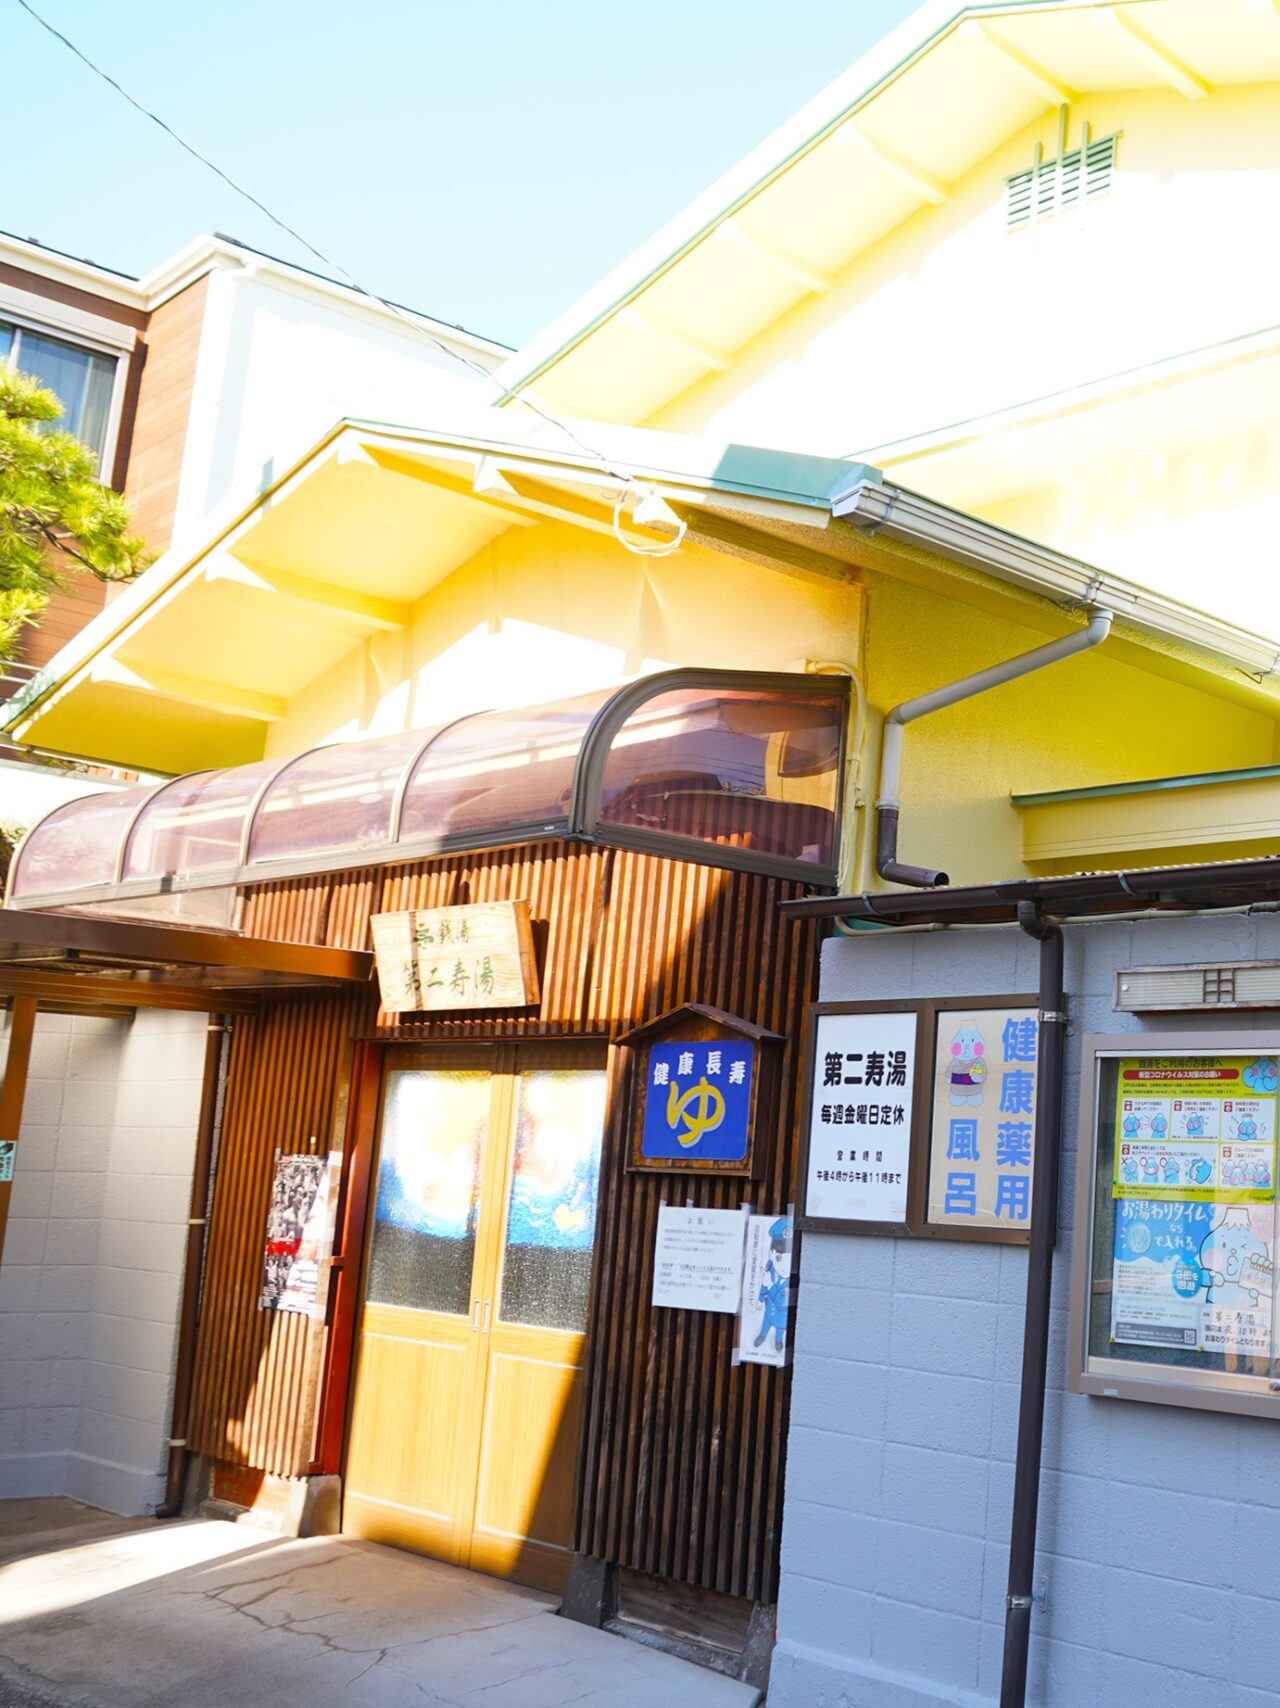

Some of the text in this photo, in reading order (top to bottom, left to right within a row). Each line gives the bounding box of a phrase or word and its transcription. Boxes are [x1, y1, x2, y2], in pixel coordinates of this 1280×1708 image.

[653, 1050, 746, 1086] 健康長寿
[822, 1050, 908, 1087] 第二寿湯
[666, 1075, 726, 1149] ゆ
[820, 1104, 906, 1125] 毎週金曜日定休
[994, 1017, 1038, 1221] 健康薬用
[943, 1118, 981, 1217] 風呂
[1121, 1201, 1208, 1223] お湯わりタイム
